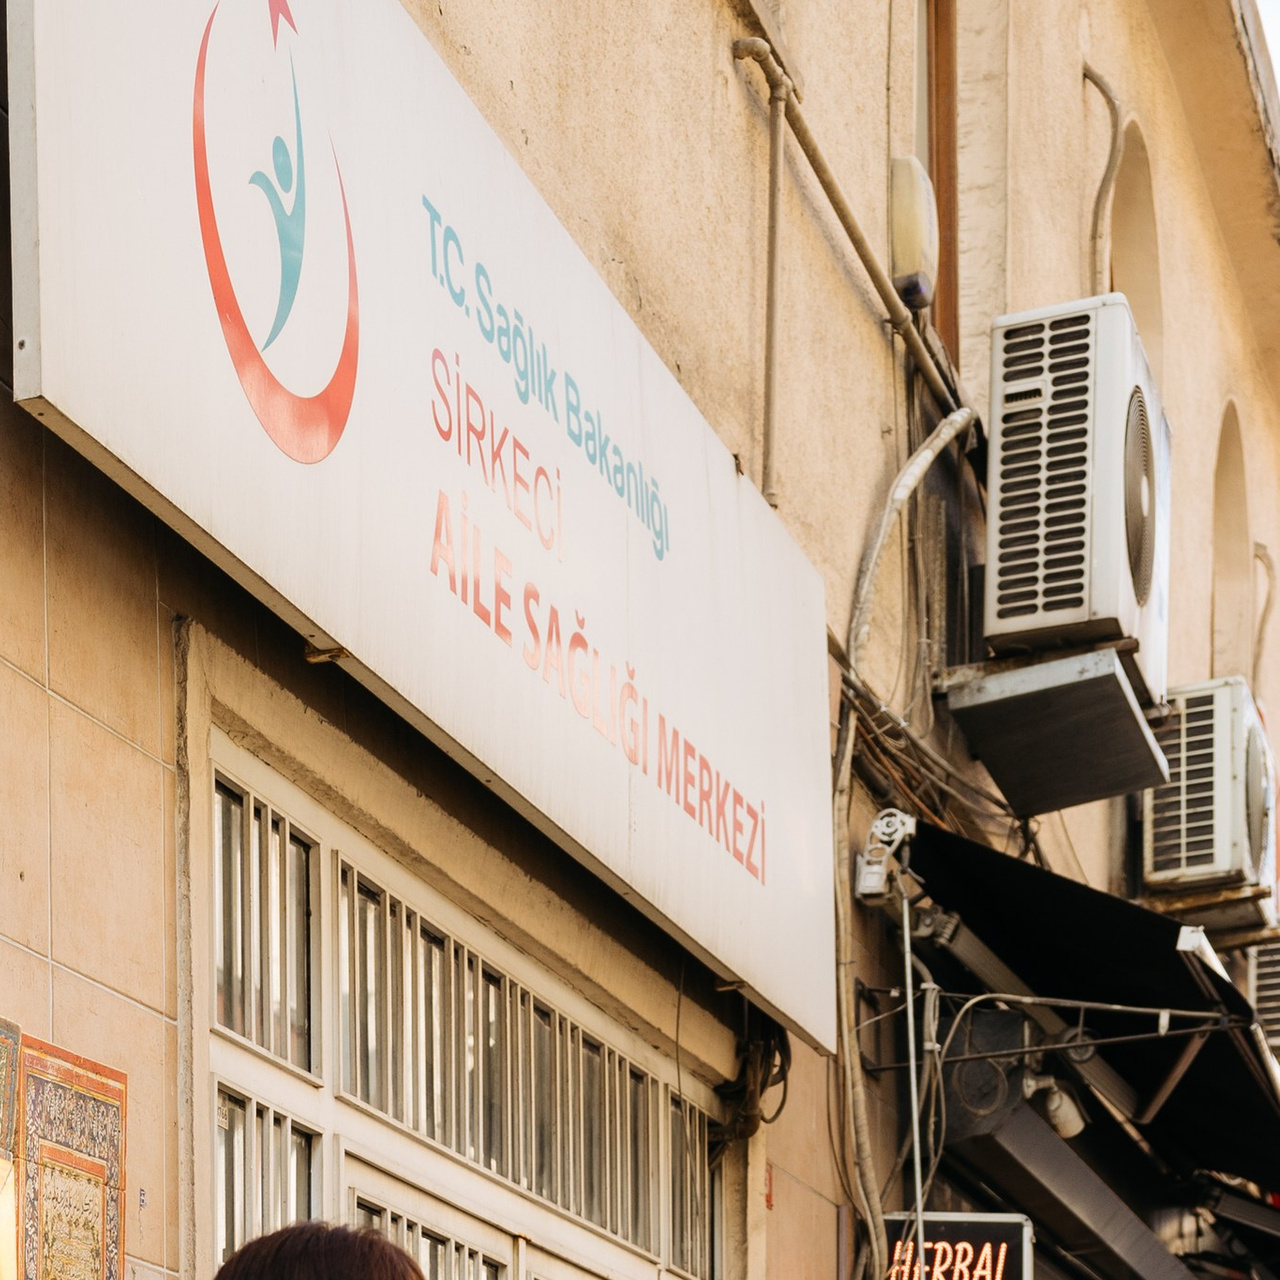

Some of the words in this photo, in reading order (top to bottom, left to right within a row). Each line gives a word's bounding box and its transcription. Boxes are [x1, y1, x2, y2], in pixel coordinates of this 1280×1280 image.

[422, 193, 470, 319] T.C.
[475, 262, 559, 424] Sağlık
[564, 371, 669, 561] Bakanlığı
[431, 348, 562, 563] SİRKECİ
[430, 489, 512, 648] AİLE
[523, 582, 647, 776] SAĞLIĞI
[657, 713, 766, 886] MERKEZİ
